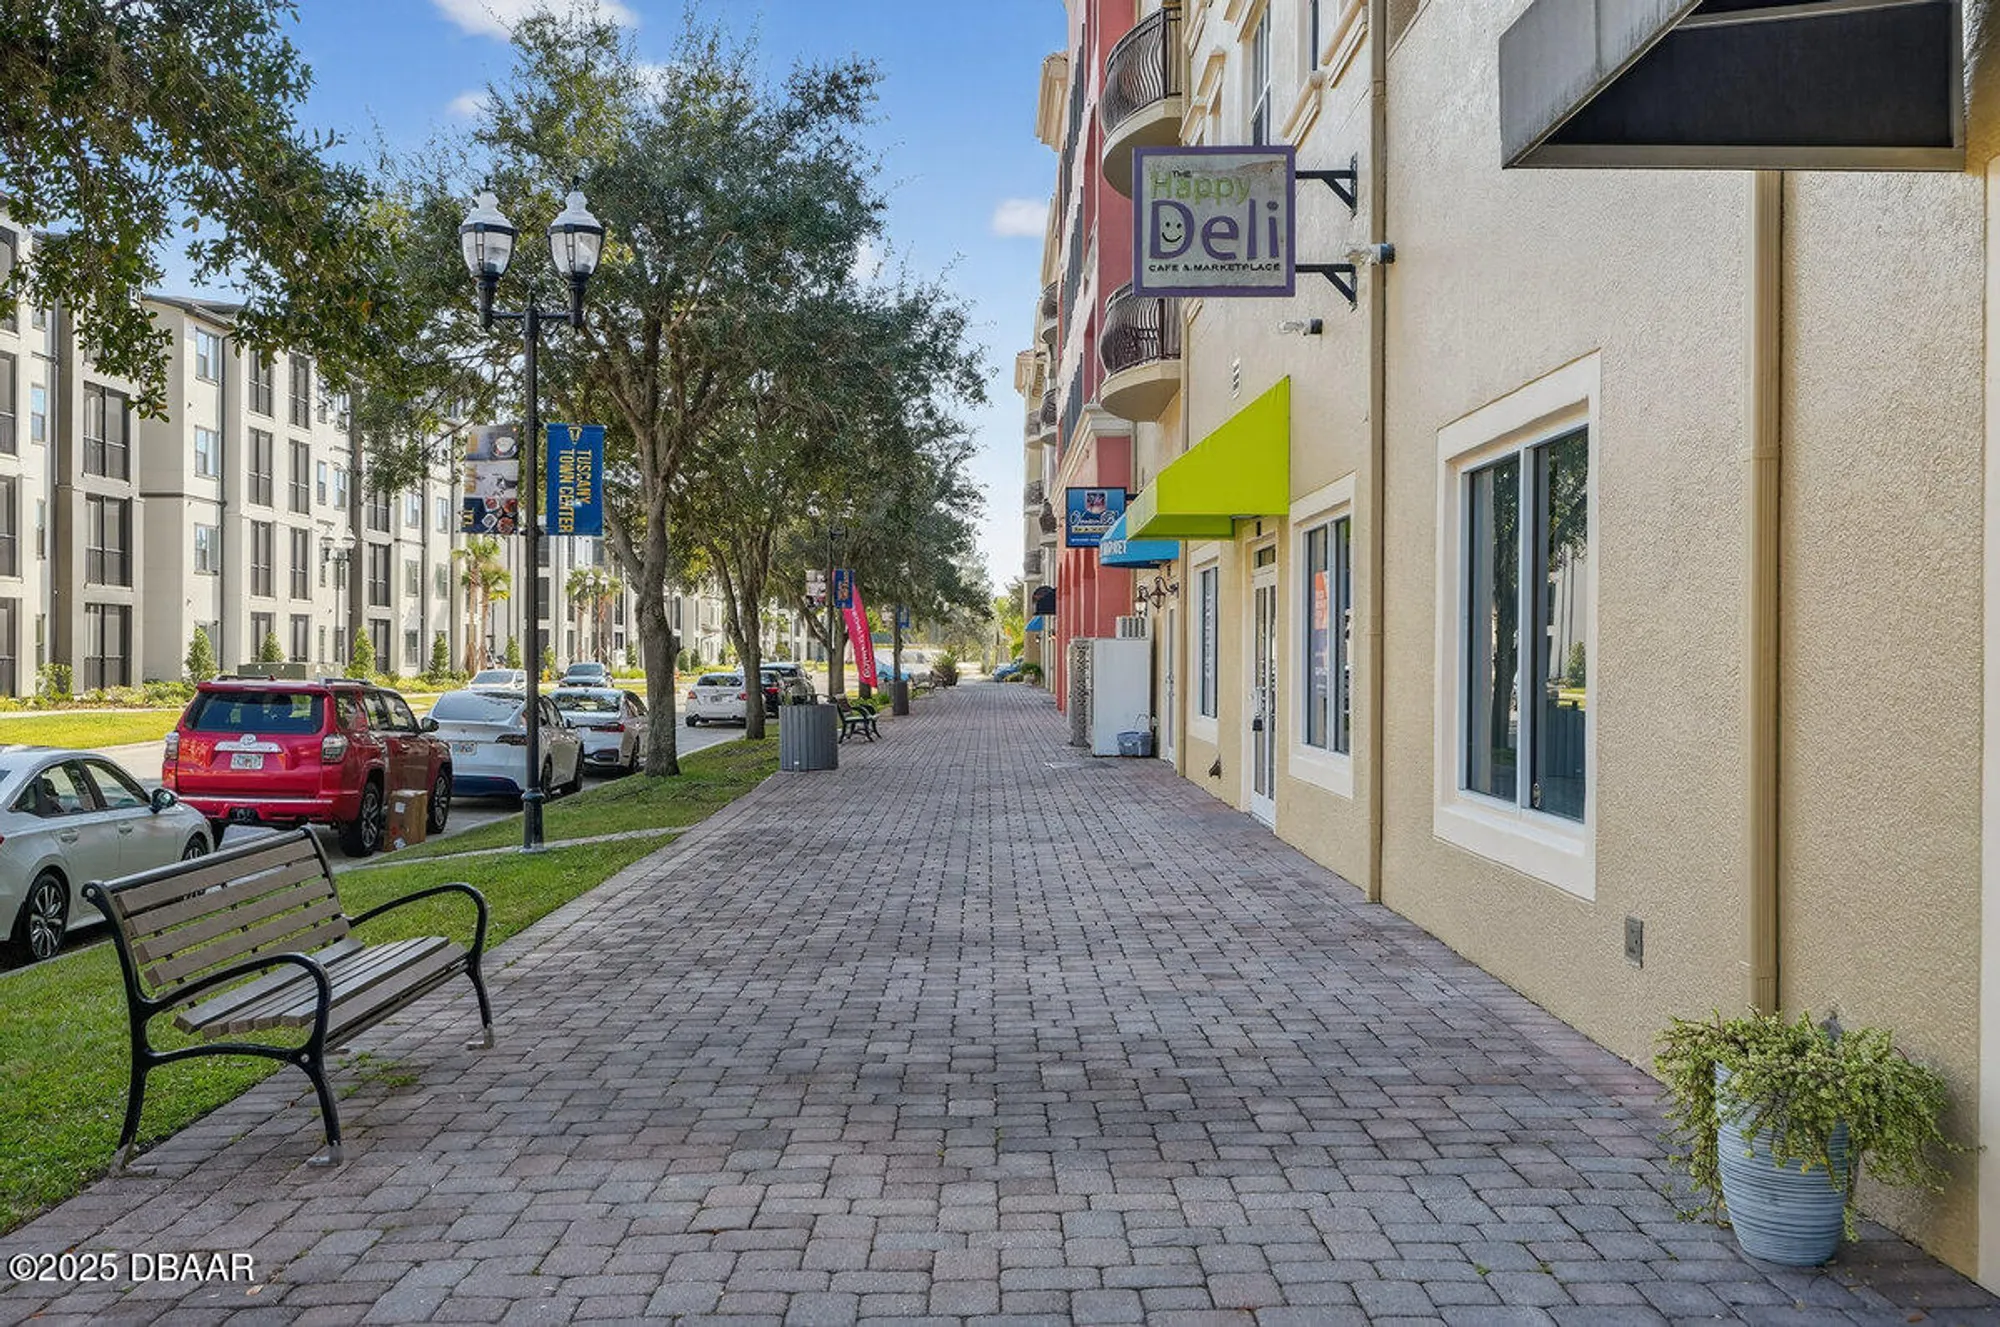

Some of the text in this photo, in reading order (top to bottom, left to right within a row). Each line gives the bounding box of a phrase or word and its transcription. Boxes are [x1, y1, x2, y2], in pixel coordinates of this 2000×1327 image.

[1149, 170, 1251, 206] Happy
[1149, 198, 1280, 261] Deli
[1149, 264, 1179, 272] CAFE
[1193, 262, 1281, 272] MARKETPLACE
[558, 449, 575, 534] TOWN CENTER
[576, 449, 592, 505] TUSCANY
